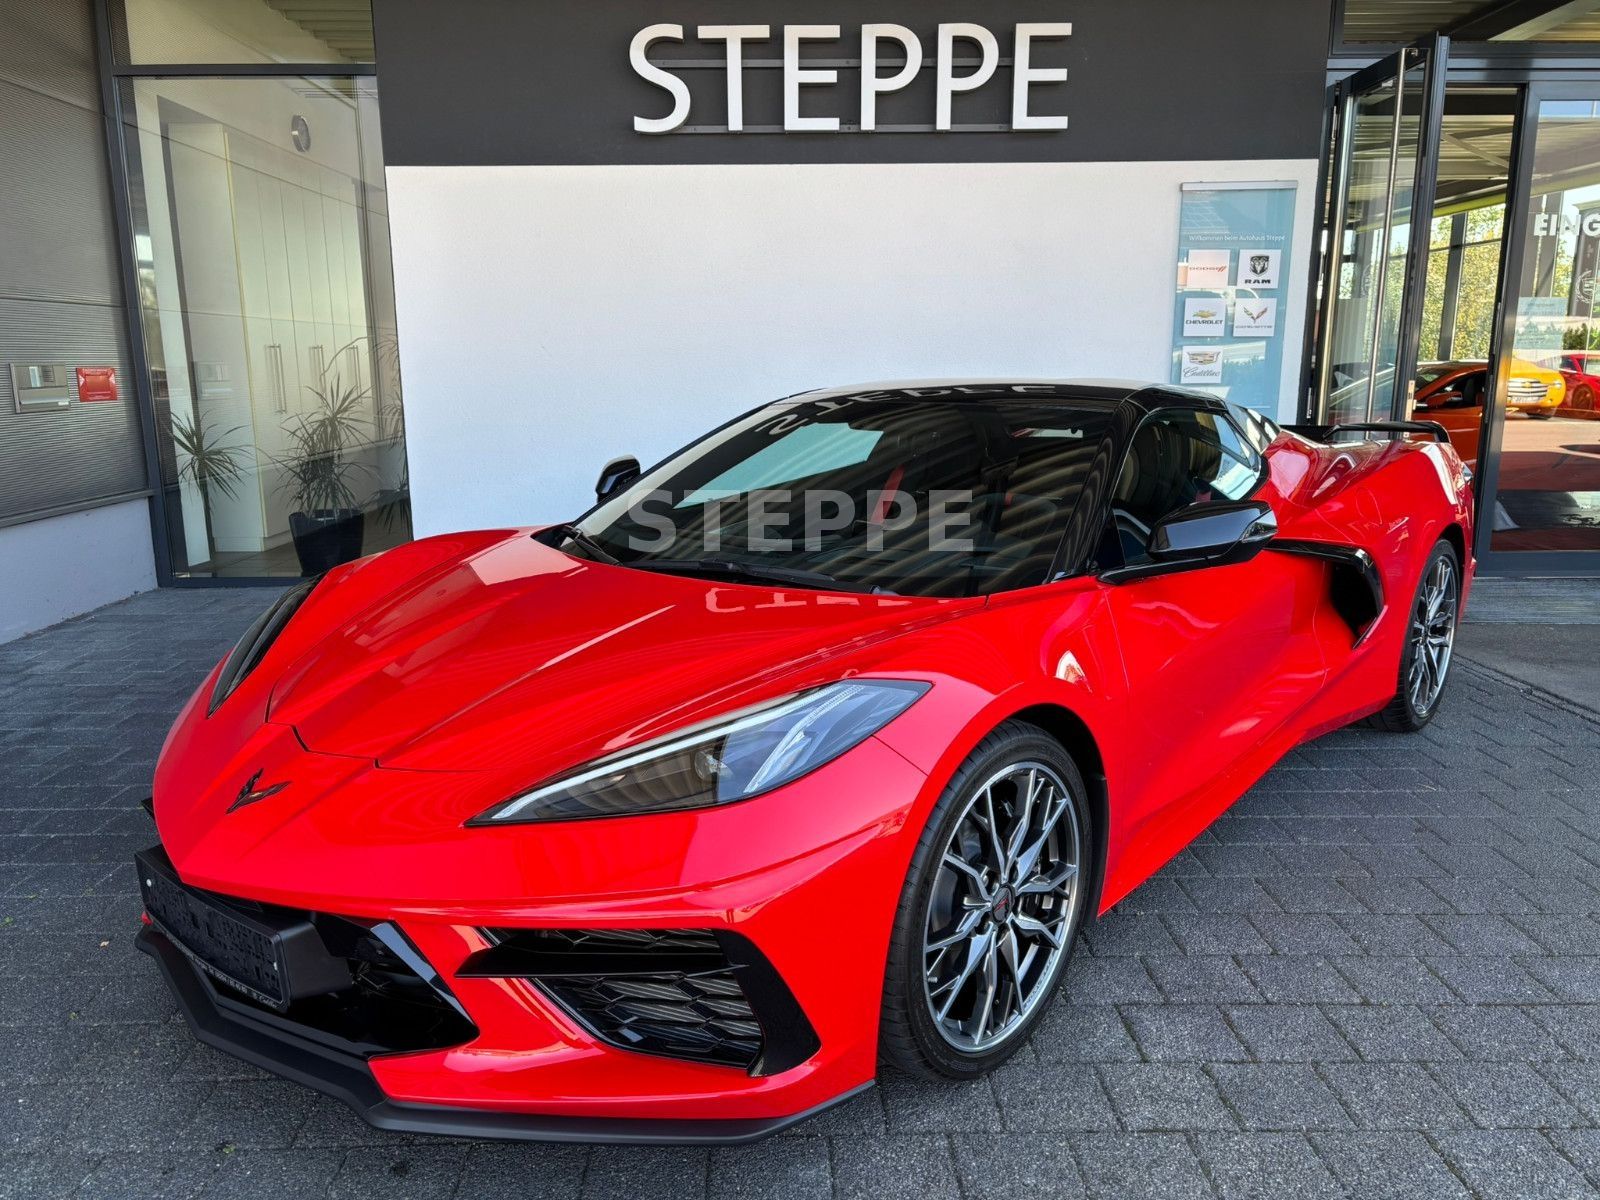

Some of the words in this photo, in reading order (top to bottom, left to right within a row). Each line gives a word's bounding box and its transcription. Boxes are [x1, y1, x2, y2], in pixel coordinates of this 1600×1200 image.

[629, 22, 1073, 134] STEPPE
[1265, 234, 1285, 242] Steppe
[1183, 367, 1221, 378] Cadillac
